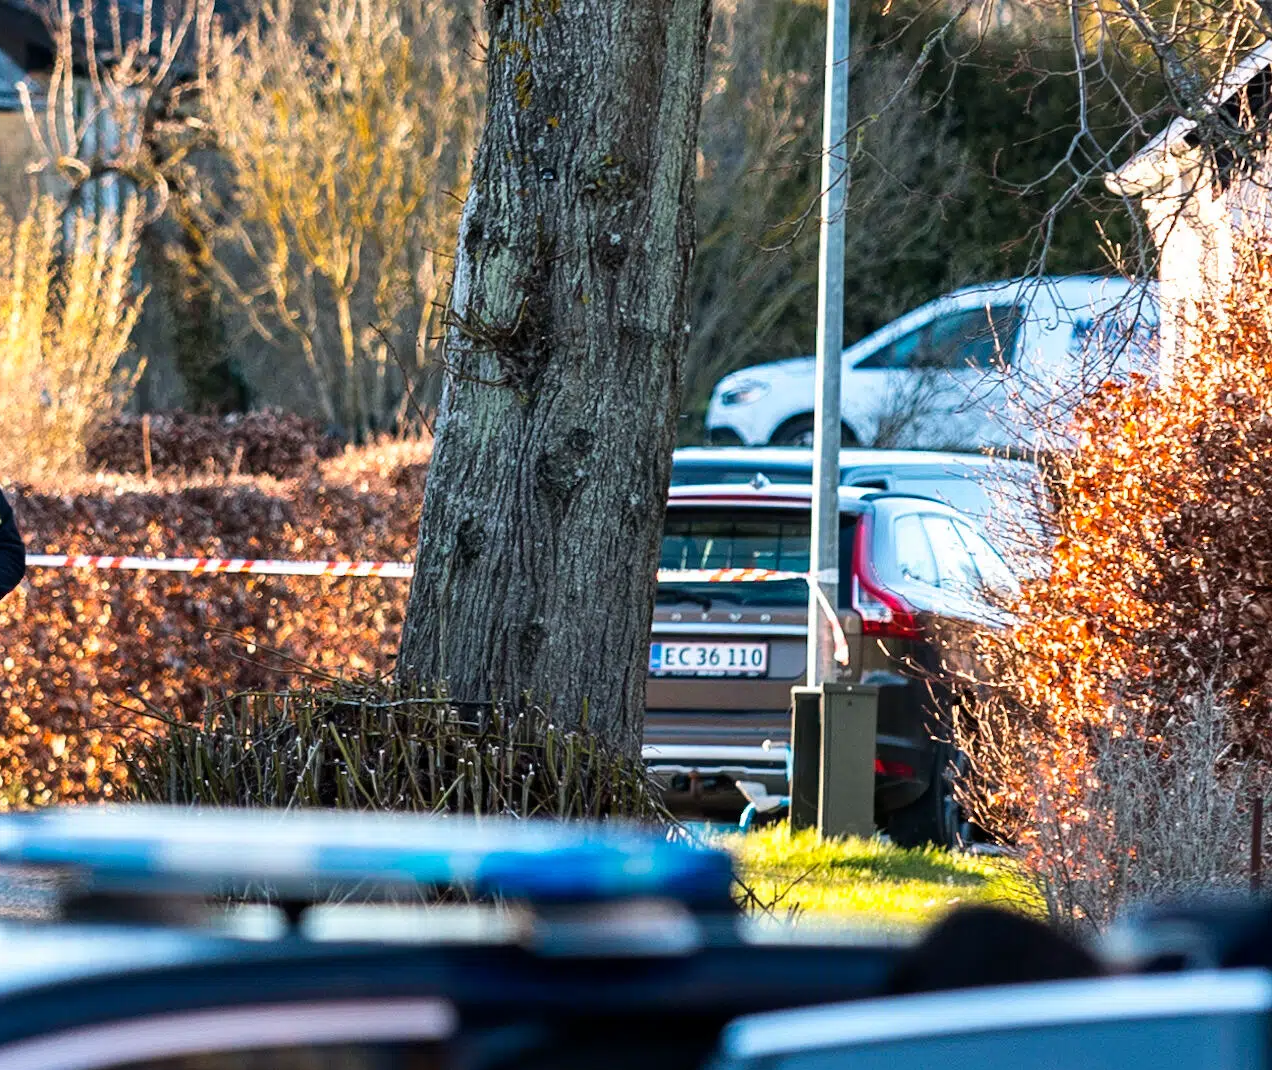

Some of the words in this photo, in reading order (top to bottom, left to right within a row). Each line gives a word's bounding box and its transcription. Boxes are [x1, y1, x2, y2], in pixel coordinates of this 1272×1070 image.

[664, 647, 692, 666] EC
[696, 648, 721, 666] 36
[727, 648, 763, 667] 110
